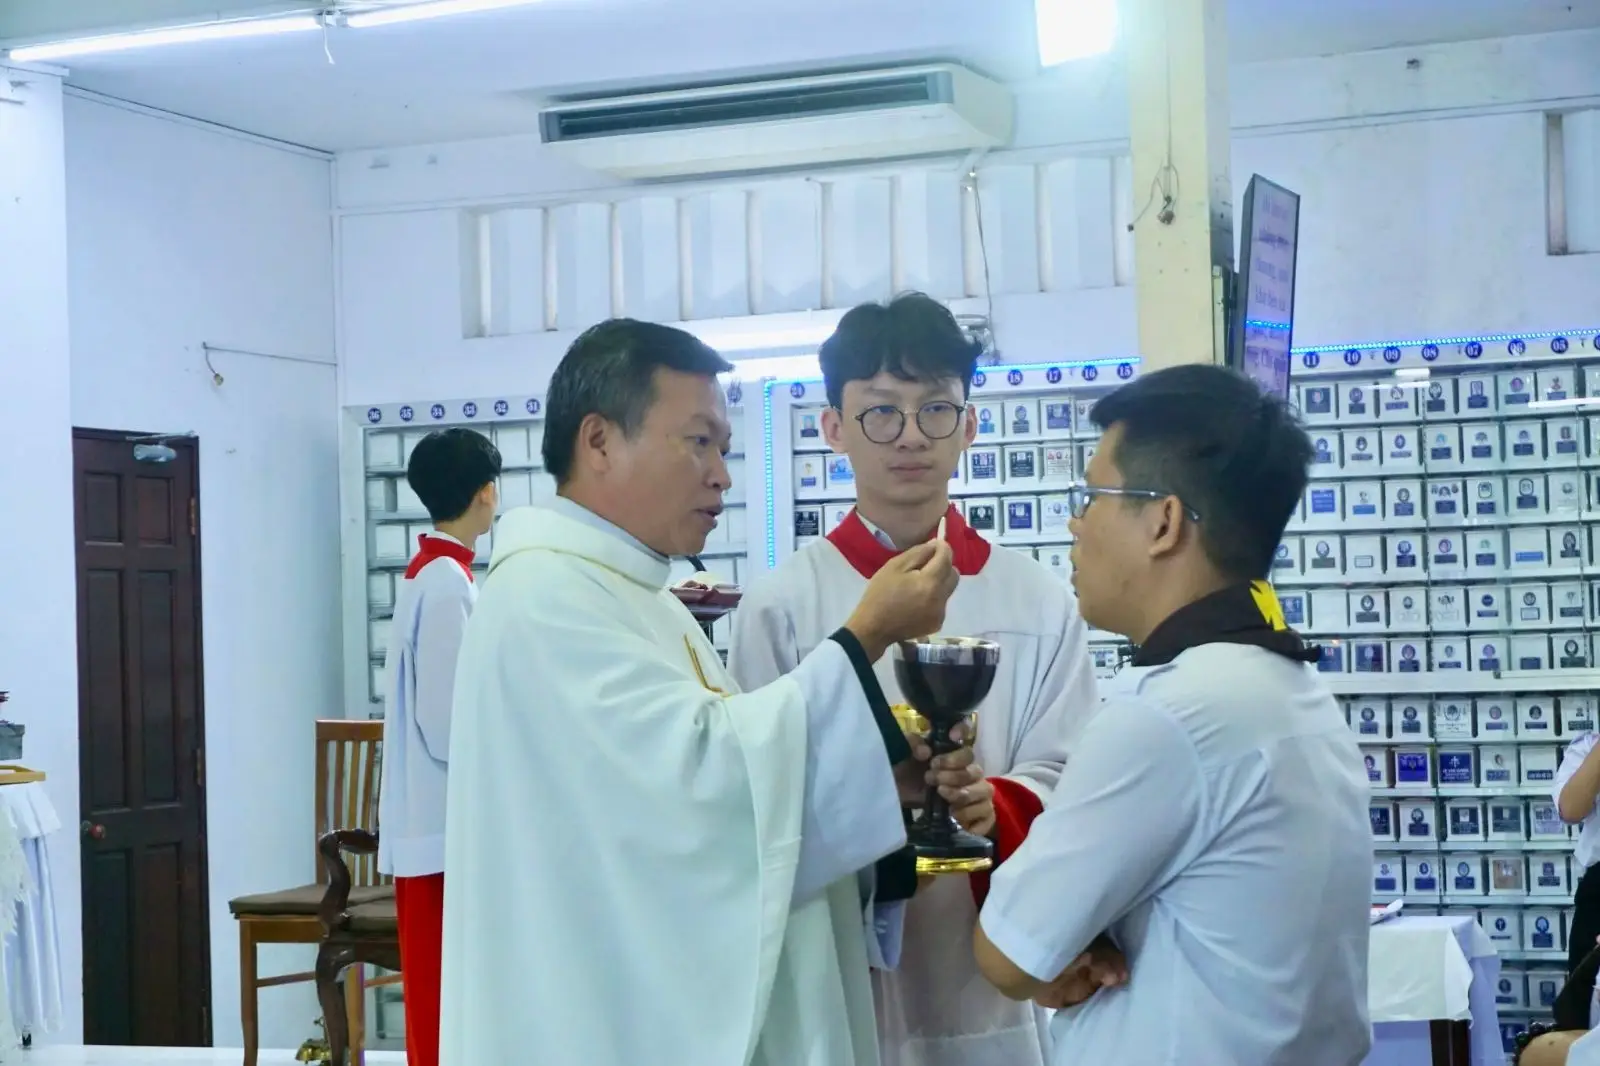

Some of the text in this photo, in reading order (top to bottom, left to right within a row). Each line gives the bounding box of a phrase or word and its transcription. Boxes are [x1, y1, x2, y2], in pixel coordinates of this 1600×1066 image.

[1305, 354, 1318, 366] 11
[1345, 352, 1359, 363] 10
[1008, 372, 1022, 382] 18
[1048, 370, 1061, 381] 17
[1083, 367, 1097, 378] 16
[1118, 366, 1131, 377] 15
[400, 408, 412, 419] 35
